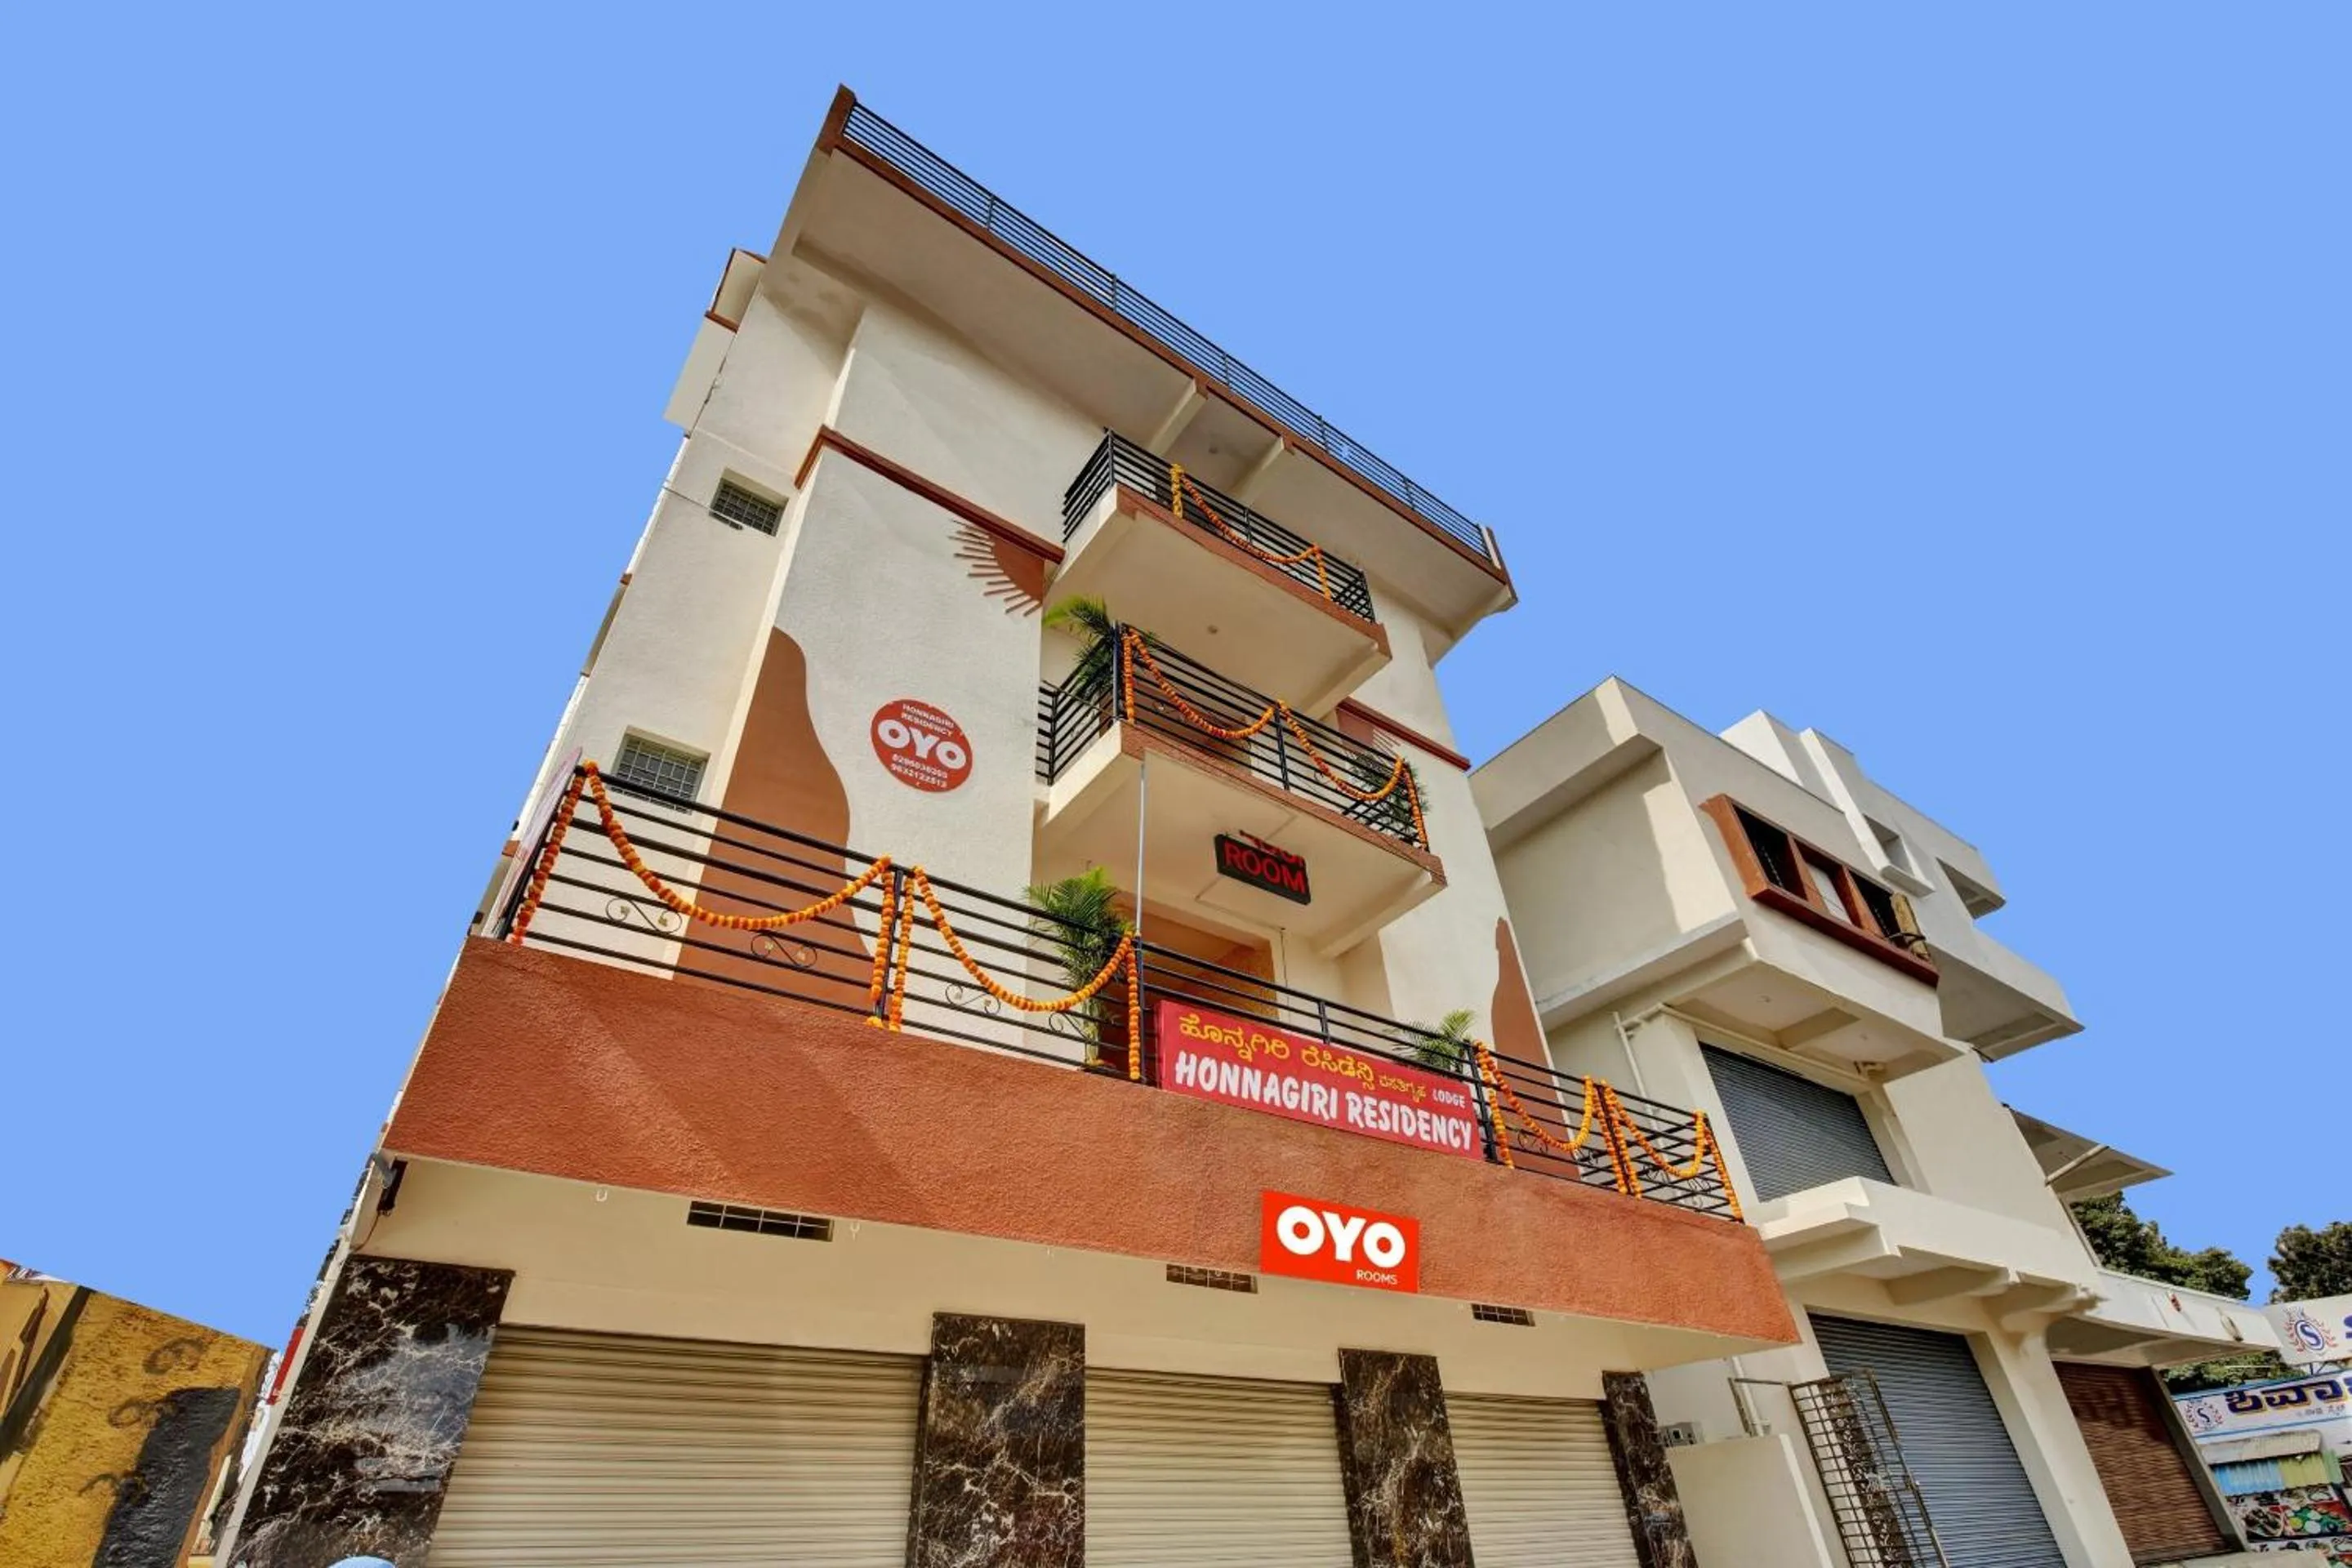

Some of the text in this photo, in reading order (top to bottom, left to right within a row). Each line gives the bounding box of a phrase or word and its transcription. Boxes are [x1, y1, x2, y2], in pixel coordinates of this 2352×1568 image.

[878, 719, 966, 769] OYO
[1224, 840, 1306, 894] ROOM
[1179, 1013, 1290, 1062] ಹೊನ್ನಗಿರಿ
[1432, 1088, 1466, 1109] LODGE
[1175, 1050, 1472, 1151] HONNAGIRI RESIDENCY
[1276, 1205, 1406, 1268] OYO
[1356, 1268, 1398, 1285] ROOMS
